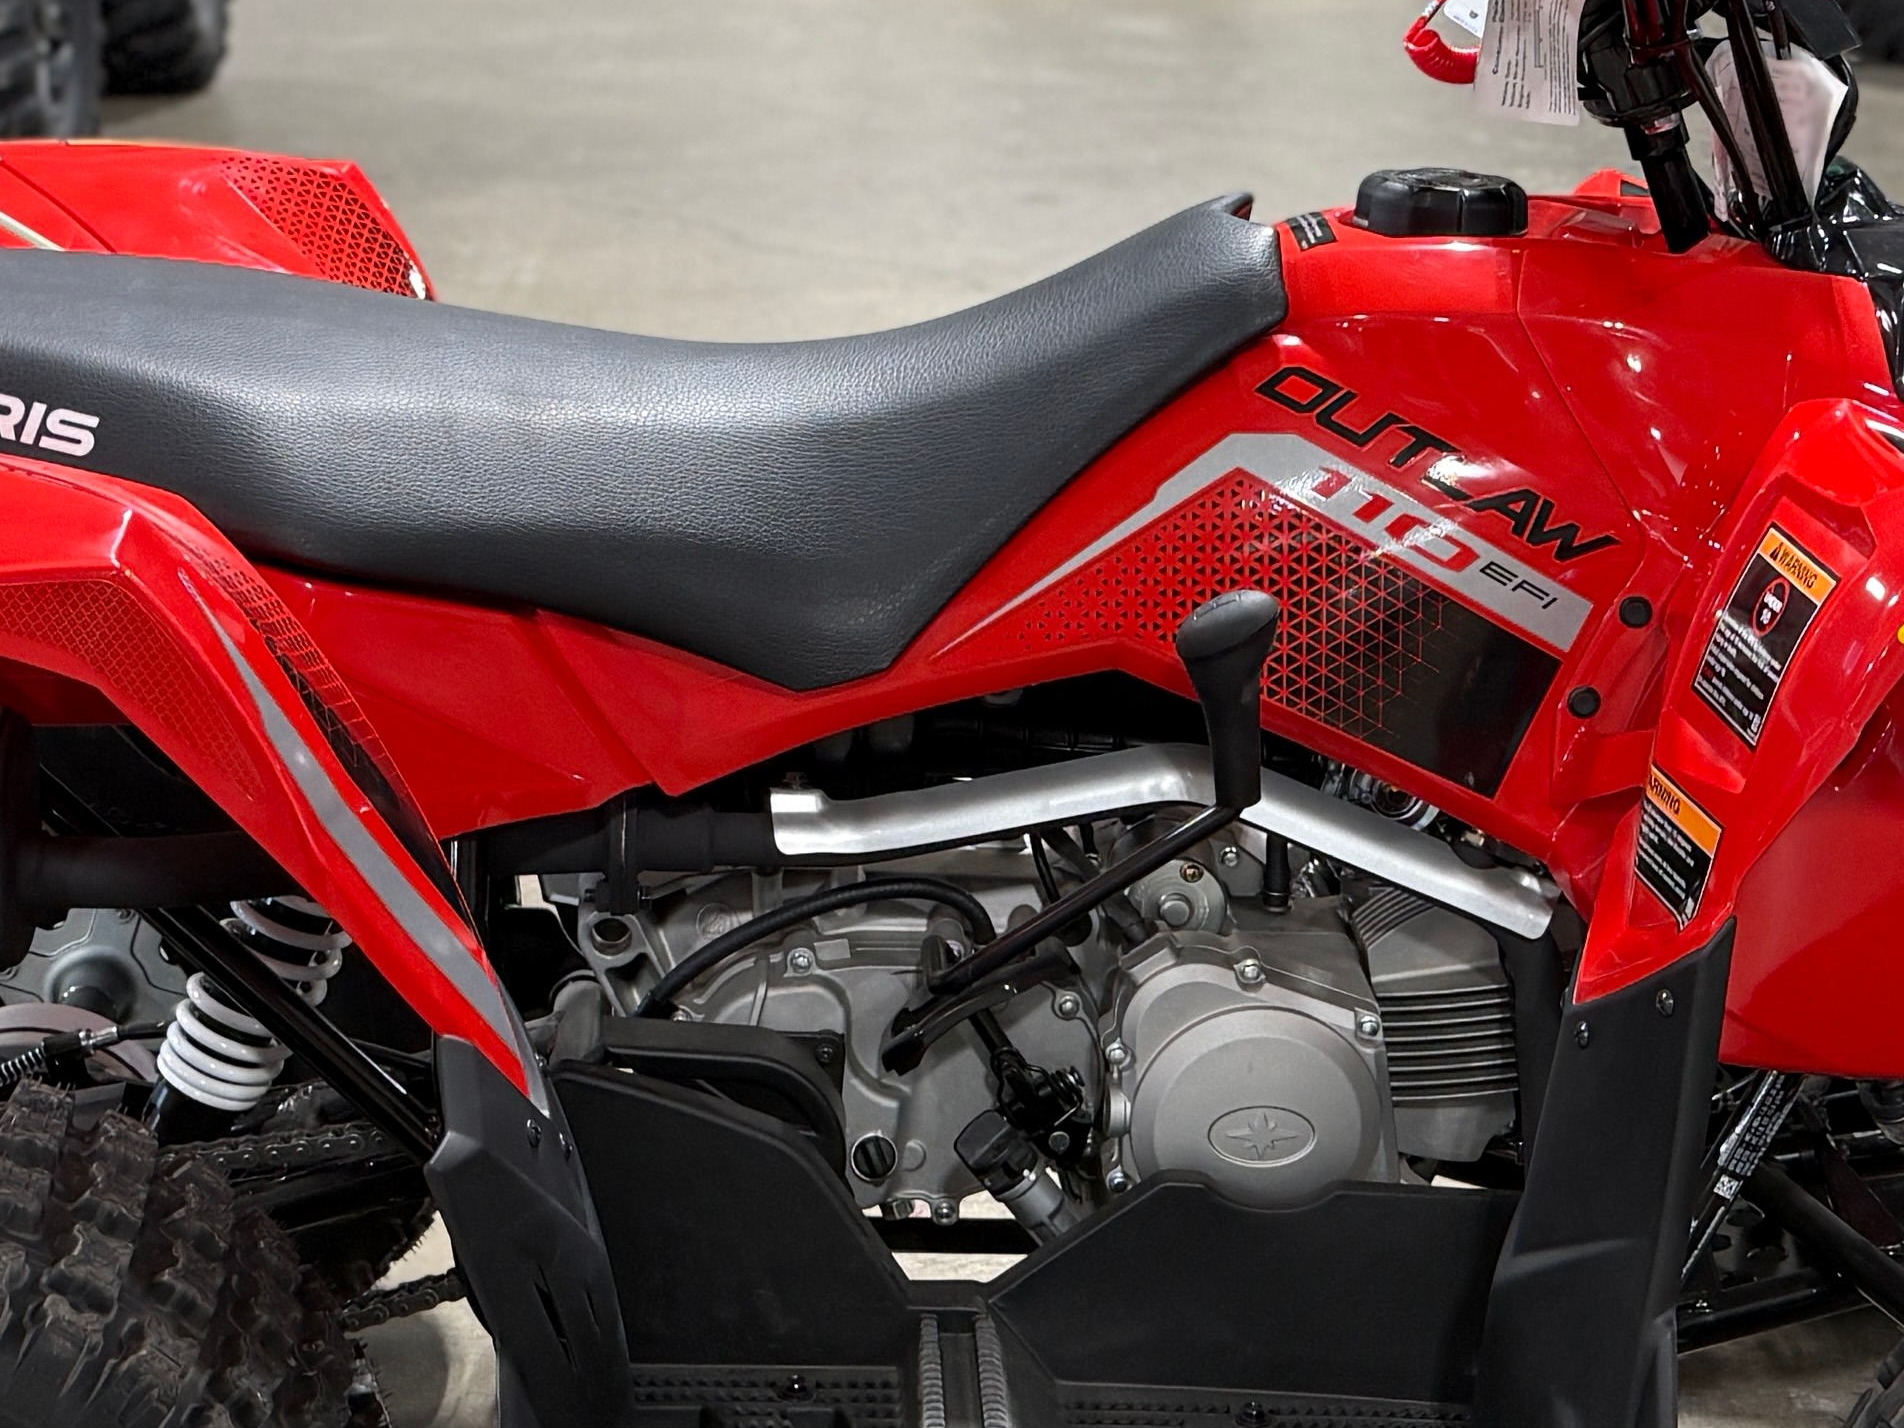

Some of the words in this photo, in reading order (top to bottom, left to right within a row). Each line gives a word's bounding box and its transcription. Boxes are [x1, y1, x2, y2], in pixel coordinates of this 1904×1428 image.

[1254, 366, 1622, 562] OUTLAW
[1314, 465, 1481, 573] 110
[1478, 560, 1558, 610] EFI
[1777, 540, 1818, 591] WARNING
